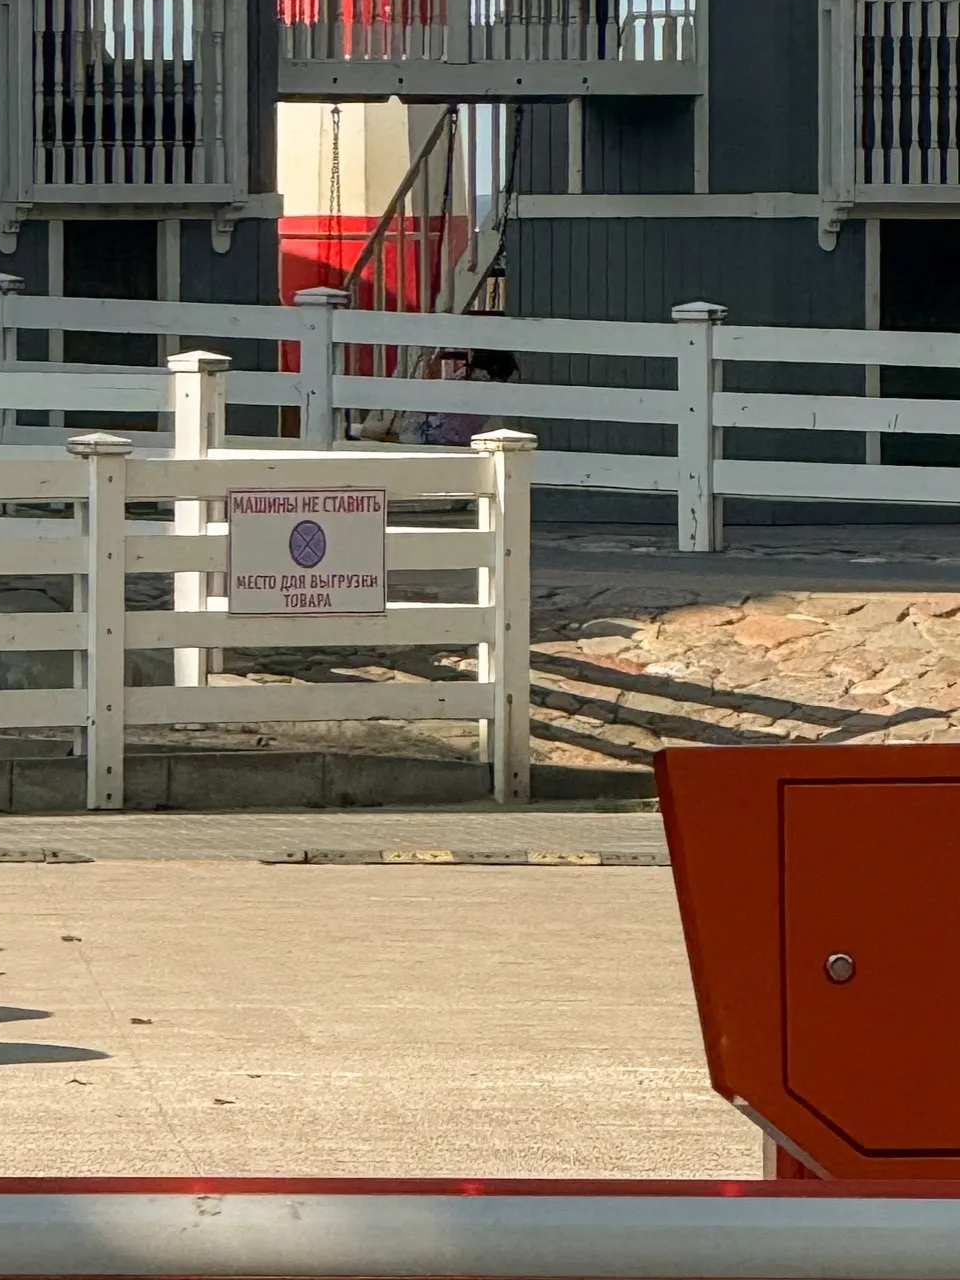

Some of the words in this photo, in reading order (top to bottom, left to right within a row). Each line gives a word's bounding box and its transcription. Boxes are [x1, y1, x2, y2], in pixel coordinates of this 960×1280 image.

[233, 496, 298, 514] МАШИНЫ
[302, 496, 321, 513] НЕ
[323, 495, 381, 513] СТАВИТЬ
[236, 575, 276, 590] МЕСТО
[280, 575, 306, 591] ДЛЯ
[310, 574, 378, 589] ВЫГРУЗКИ
[283, 593, 332, 608] ТОВАРА
